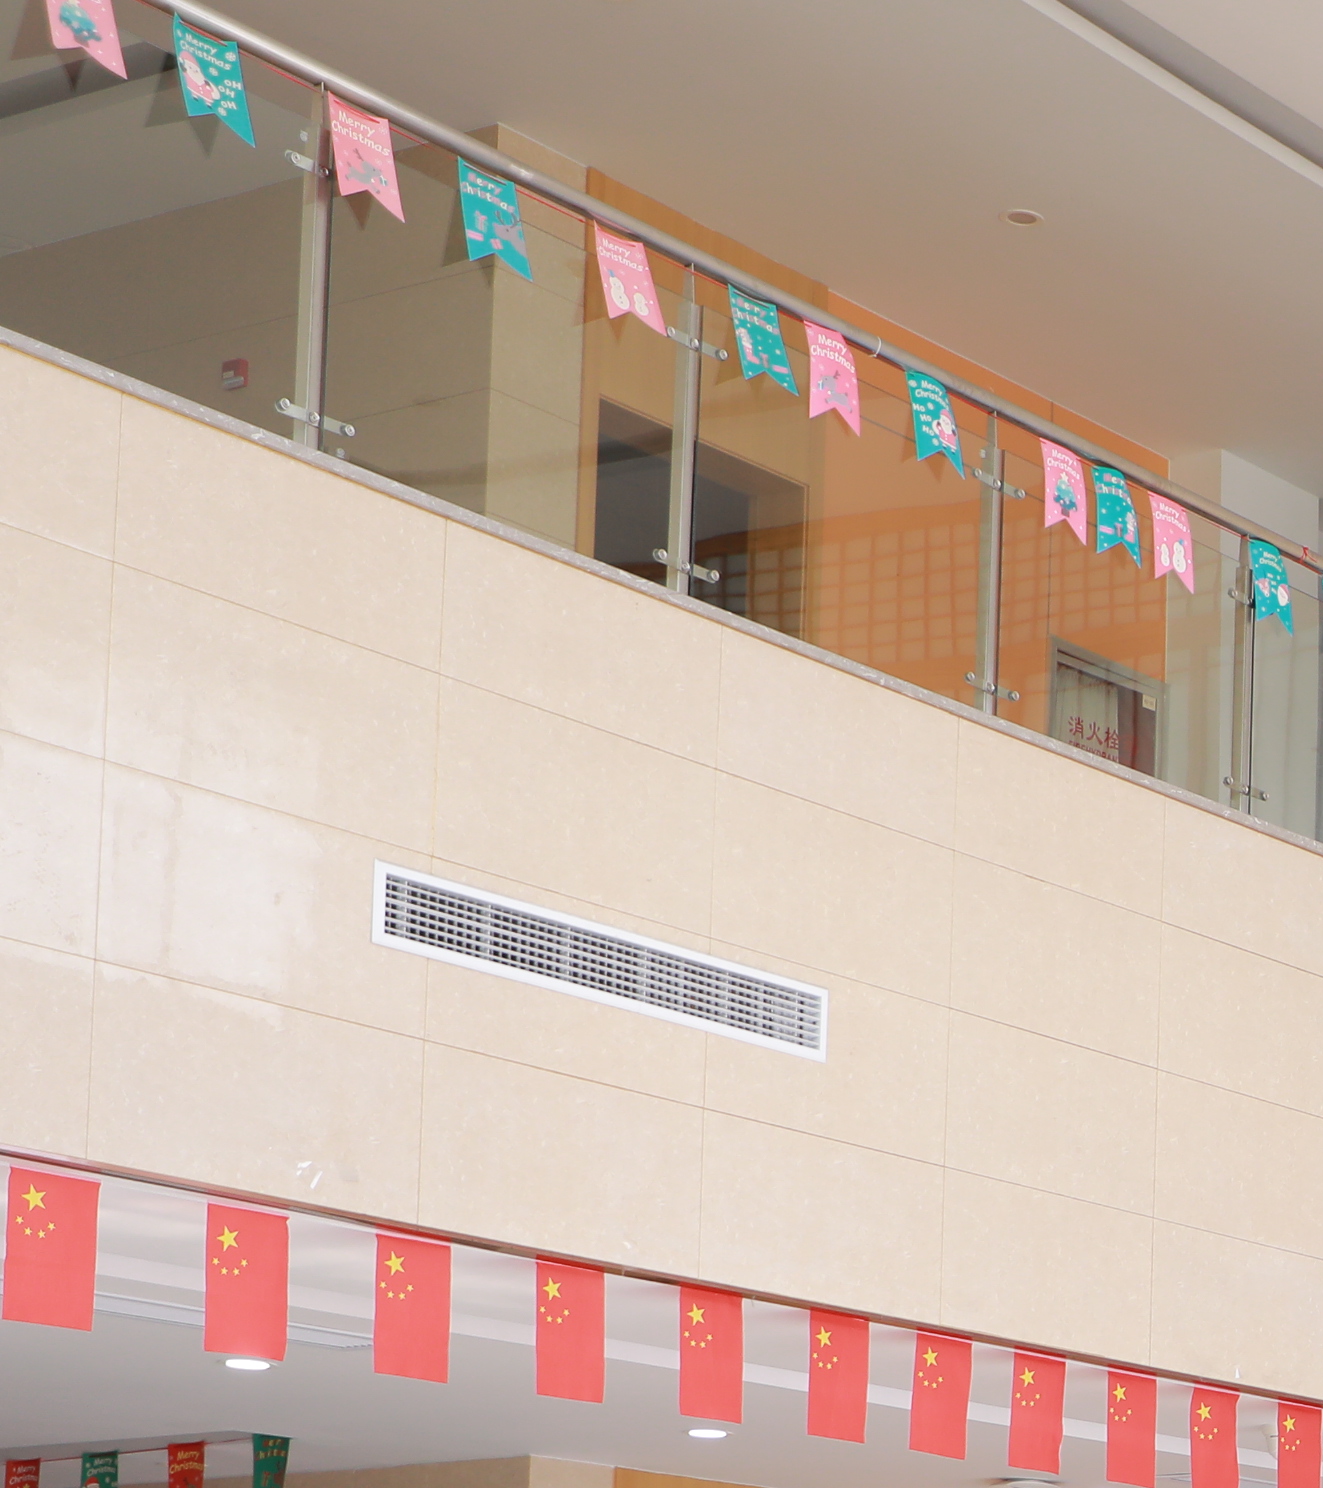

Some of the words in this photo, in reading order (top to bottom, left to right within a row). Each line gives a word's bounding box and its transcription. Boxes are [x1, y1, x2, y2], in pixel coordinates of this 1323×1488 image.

[185, 33, 217, 55] Merry
[180, 40, 232, 71] Christmas
[338, 110, 376, 138] Merry
[331, 120, 391, 156] Christmas
[599, 245, 644, 272] Christmas
[602, 237, 631, 258] Merry
[817, 333, 847, 356] Merry
[810, 344, 856, 374] Christmas
[921, 380, 943, 397] Merry
[912, 403, 926, 412] Ho
[920, 413, 932, 422] Ho
[922, 425, 935, 437] Ho
[1051, 448, 1073, 466] Merry
[1046, 457, 1080, 480] Christmas
[1155, 510, 1187, 533] Christmas
[1159, 502, 1180, 519] Merry
[1068, 715, 1120, 750] 消火栓
[176, 1450, 200, 1461] Merry
